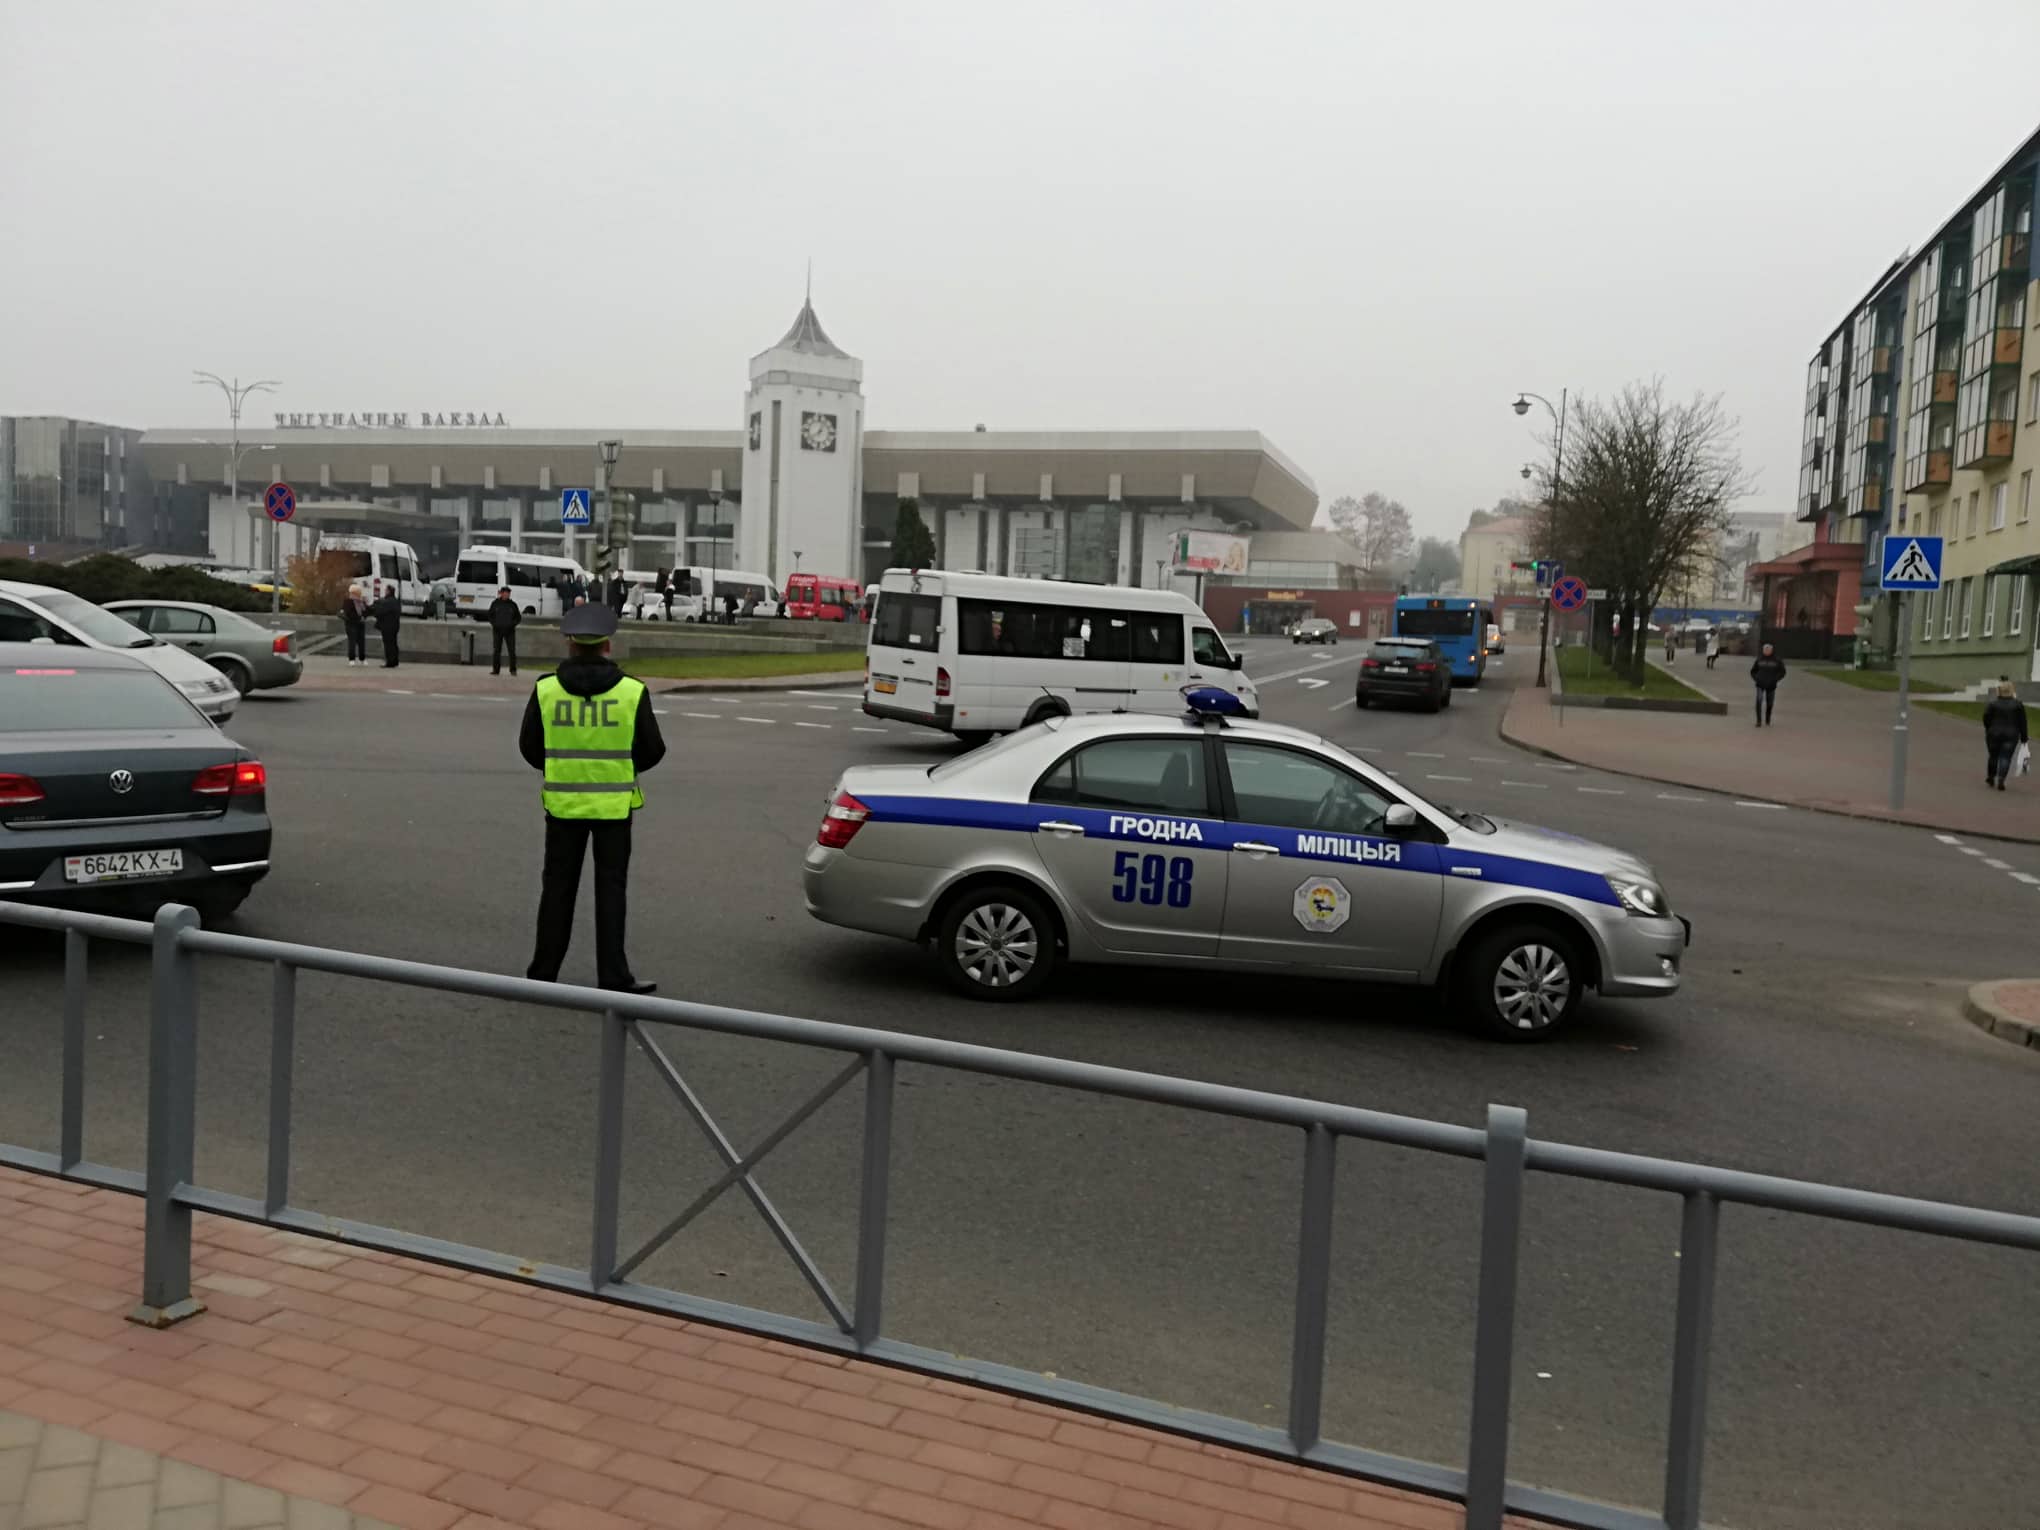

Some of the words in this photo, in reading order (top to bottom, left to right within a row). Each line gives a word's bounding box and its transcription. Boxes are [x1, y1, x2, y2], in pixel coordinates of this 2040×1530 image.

[421, 411, 505, 425] ВАКЗАЛ
[551, 700, 619, 727] ДПС
[1109, 815, 1203, 841] ГРОДНА
[1297, 834, 1401, 862] МІЛІЦЫЯ
[1111, 850, 1194, 908] 598
